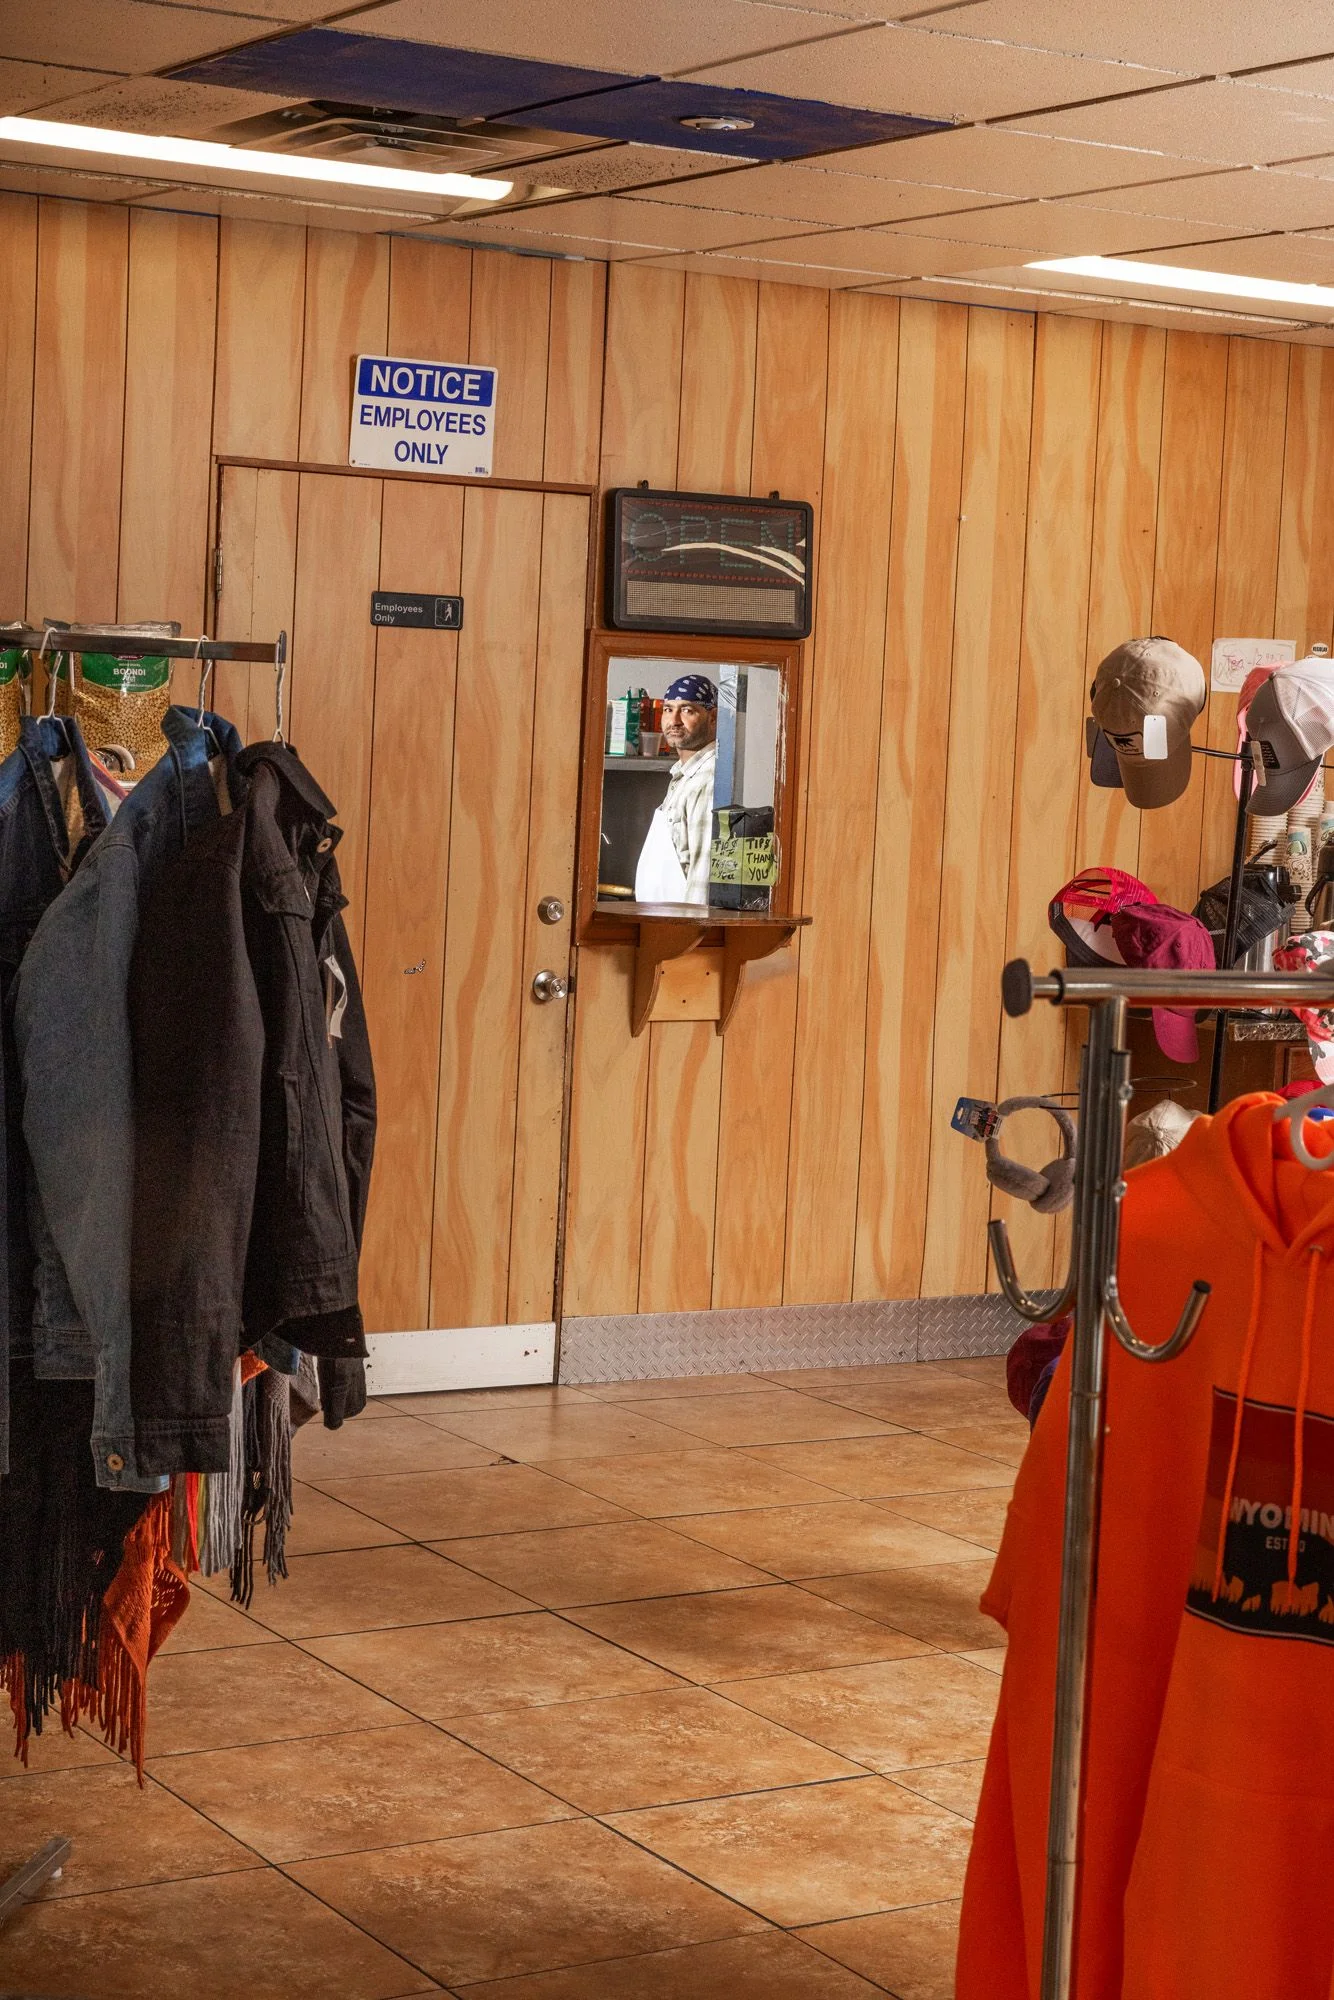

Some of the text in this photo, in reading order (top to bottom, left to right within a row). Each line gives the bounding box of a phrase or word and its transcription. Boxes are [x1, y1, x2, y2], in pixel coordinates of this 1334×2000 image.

[370, 364, 482, 402] NOTICE
[359, 404, 486, 436] EMPLOYEES
[394, 440, 449, 465] ONLY
[630, 512, 794, 570] OPEN
[374, 602, 423, 614] Employees
[374, 613, 395, 624] Only
[113, 668, 146, 676] BOONDI
[748, 867, 770, 881] YOU
